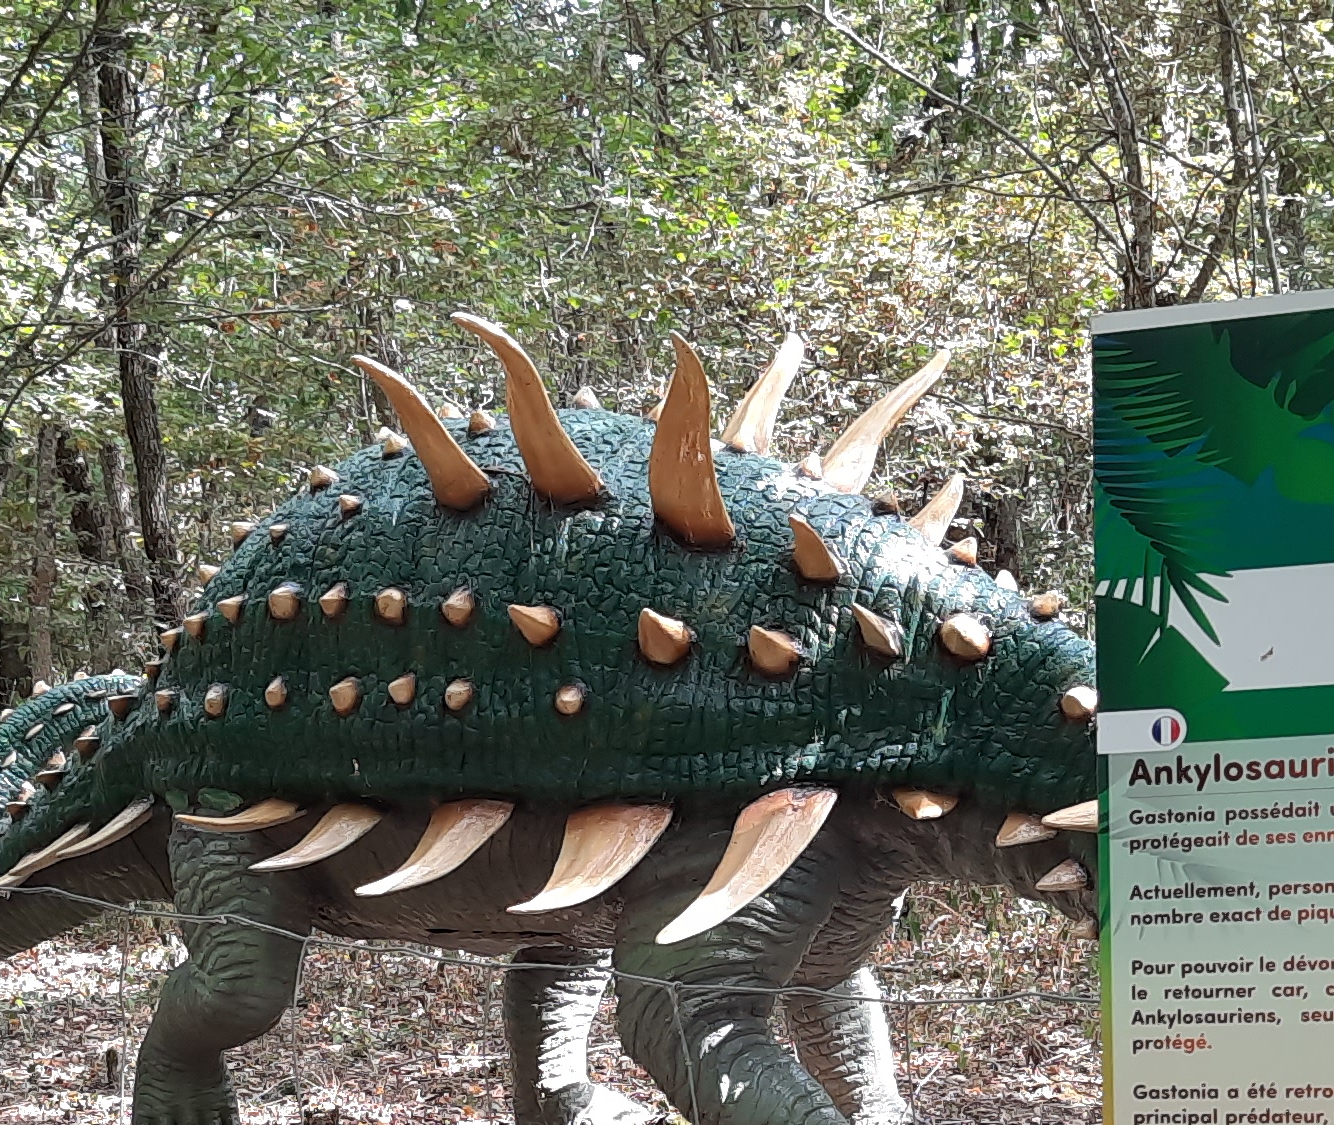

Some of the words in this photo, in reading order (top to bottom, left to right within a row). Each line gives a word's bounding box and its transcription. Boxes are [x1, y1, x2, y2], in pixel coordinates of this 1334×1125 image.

[1129, 805, 1215, 826] Gastonia
[1225, 801, 1320, 825] possédait
[1129, 830, 1231, 855] protégeait
[1235, 829, 1260, 846] de
[1265, 832, 1296, 845] ses
[1129, 881, 1260, 901] Actuellement,
[1130, 907, 1204, 926] nombre
[1209, 907, 1262, 923] exact
[1267, 905, 1292, 922] de
[1131, 959, 1176, 976] Pour
[1181, 956, 1254, 978] pouvoir
[1259, 955, 1276, 973] le
[1131, 985, 1148, 1001] le
[1164, 984, 1256, 1000] retourner
[1271, 985, 1308, 1000] car,
[1131, 1007, 1281, 1029] Ankylosauriens,
[1132, 1033, 1212, 1055] protégé.
[1133, 1083, 1219, 1100] Gastonia
[1227, 1087, 1239, 1100] a
[1247, 1082, 1278, 1099] été
